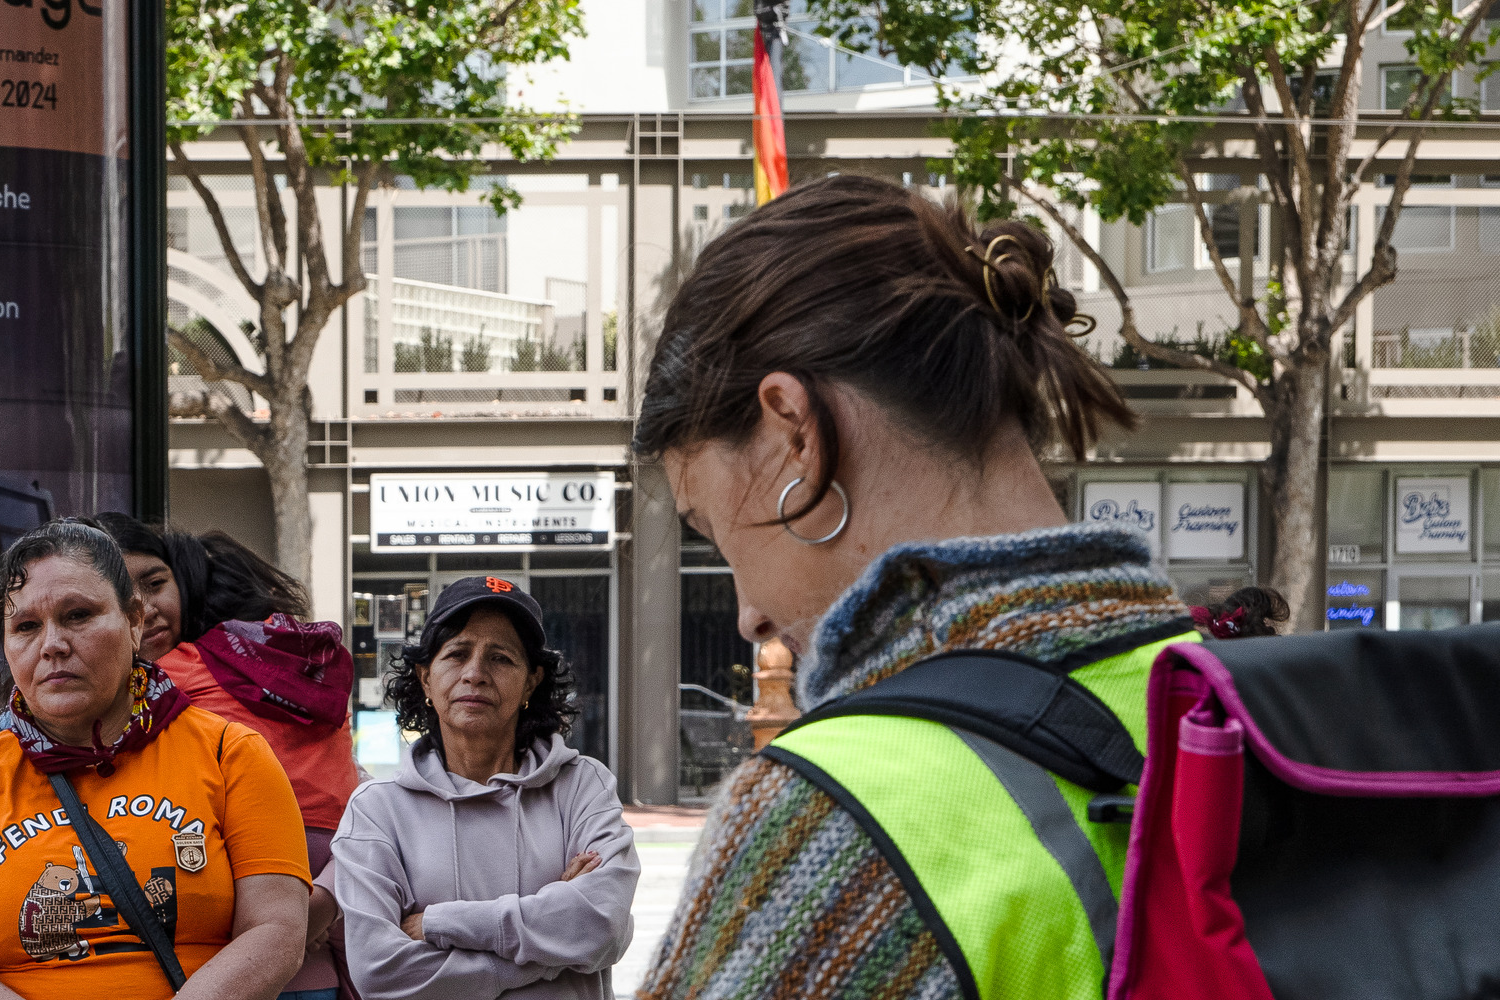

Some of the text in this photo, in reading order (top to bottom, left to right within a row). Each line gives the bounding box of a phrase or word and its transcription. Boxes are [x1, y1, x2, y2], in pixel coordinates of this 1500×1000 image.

[0, 78, 58, 111] 2024
[380, 480, 604, 504] UNION MUSIC CO.
[389, 533, 417, 546] SALES
[437, 532, 477, 546] RENTALS
[496, 532, 534, 545] REPAIRS
[1326, 580, 1370, 597] ustom
[1326, 602, 1376, 627] aming
[106, 794, 206, 834] ROMA
